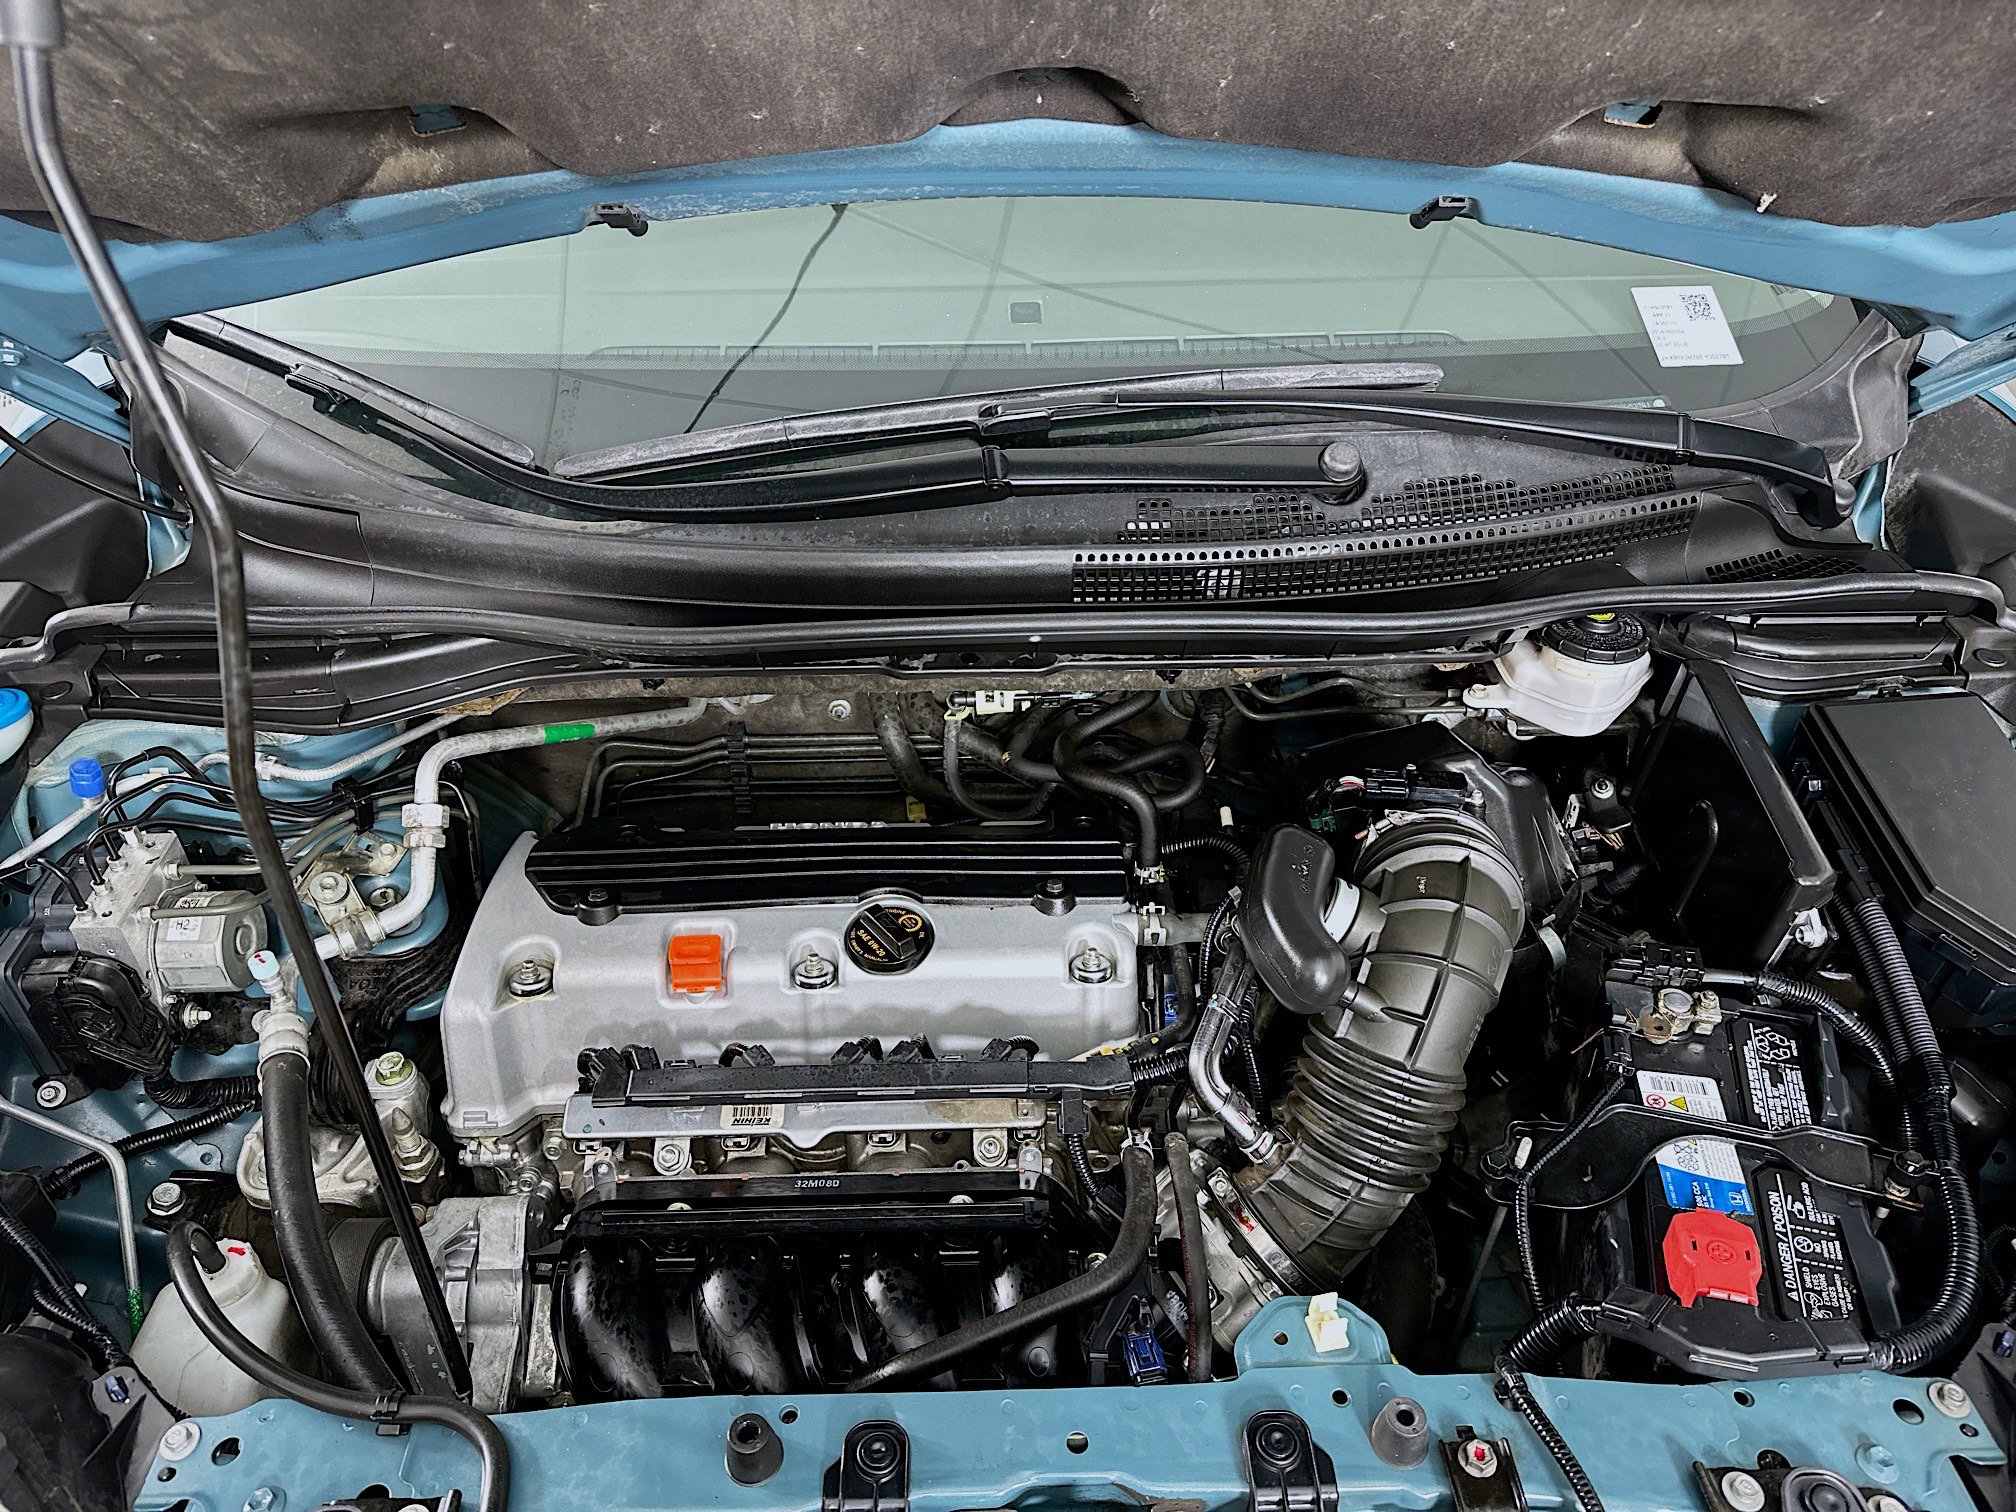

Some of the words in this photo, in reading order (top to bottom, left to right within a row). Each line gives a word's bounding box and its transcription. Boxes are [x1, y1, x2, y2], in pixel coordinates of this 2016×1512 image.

[175, 919, 190, 931] H2
[857, 929, 872, 942] SAE
[868, 940, 886, 957] 0W-20
[731, 1117, 771, 1127] KEIHIN
[1692, 1182, 1701, 1194] CCA
[1801, 1182, 1810, 1195] ACID
[1741, 1189, 1751, 1212] HONDA
[1768, 1191, 1786, 1232] POISON
[1778, 1241, 1797, 1289] DANGER
[1802, 1267, 1813, 1288] SHIELD
[1812, 1274, 1821, 1290] EYES
[1819, 1273, 1831, 1305] EXPLOSIVE
[1829, 1286, 1839, 1306] GASES
[1839, 1298, 1848, 1314] CAUSE
